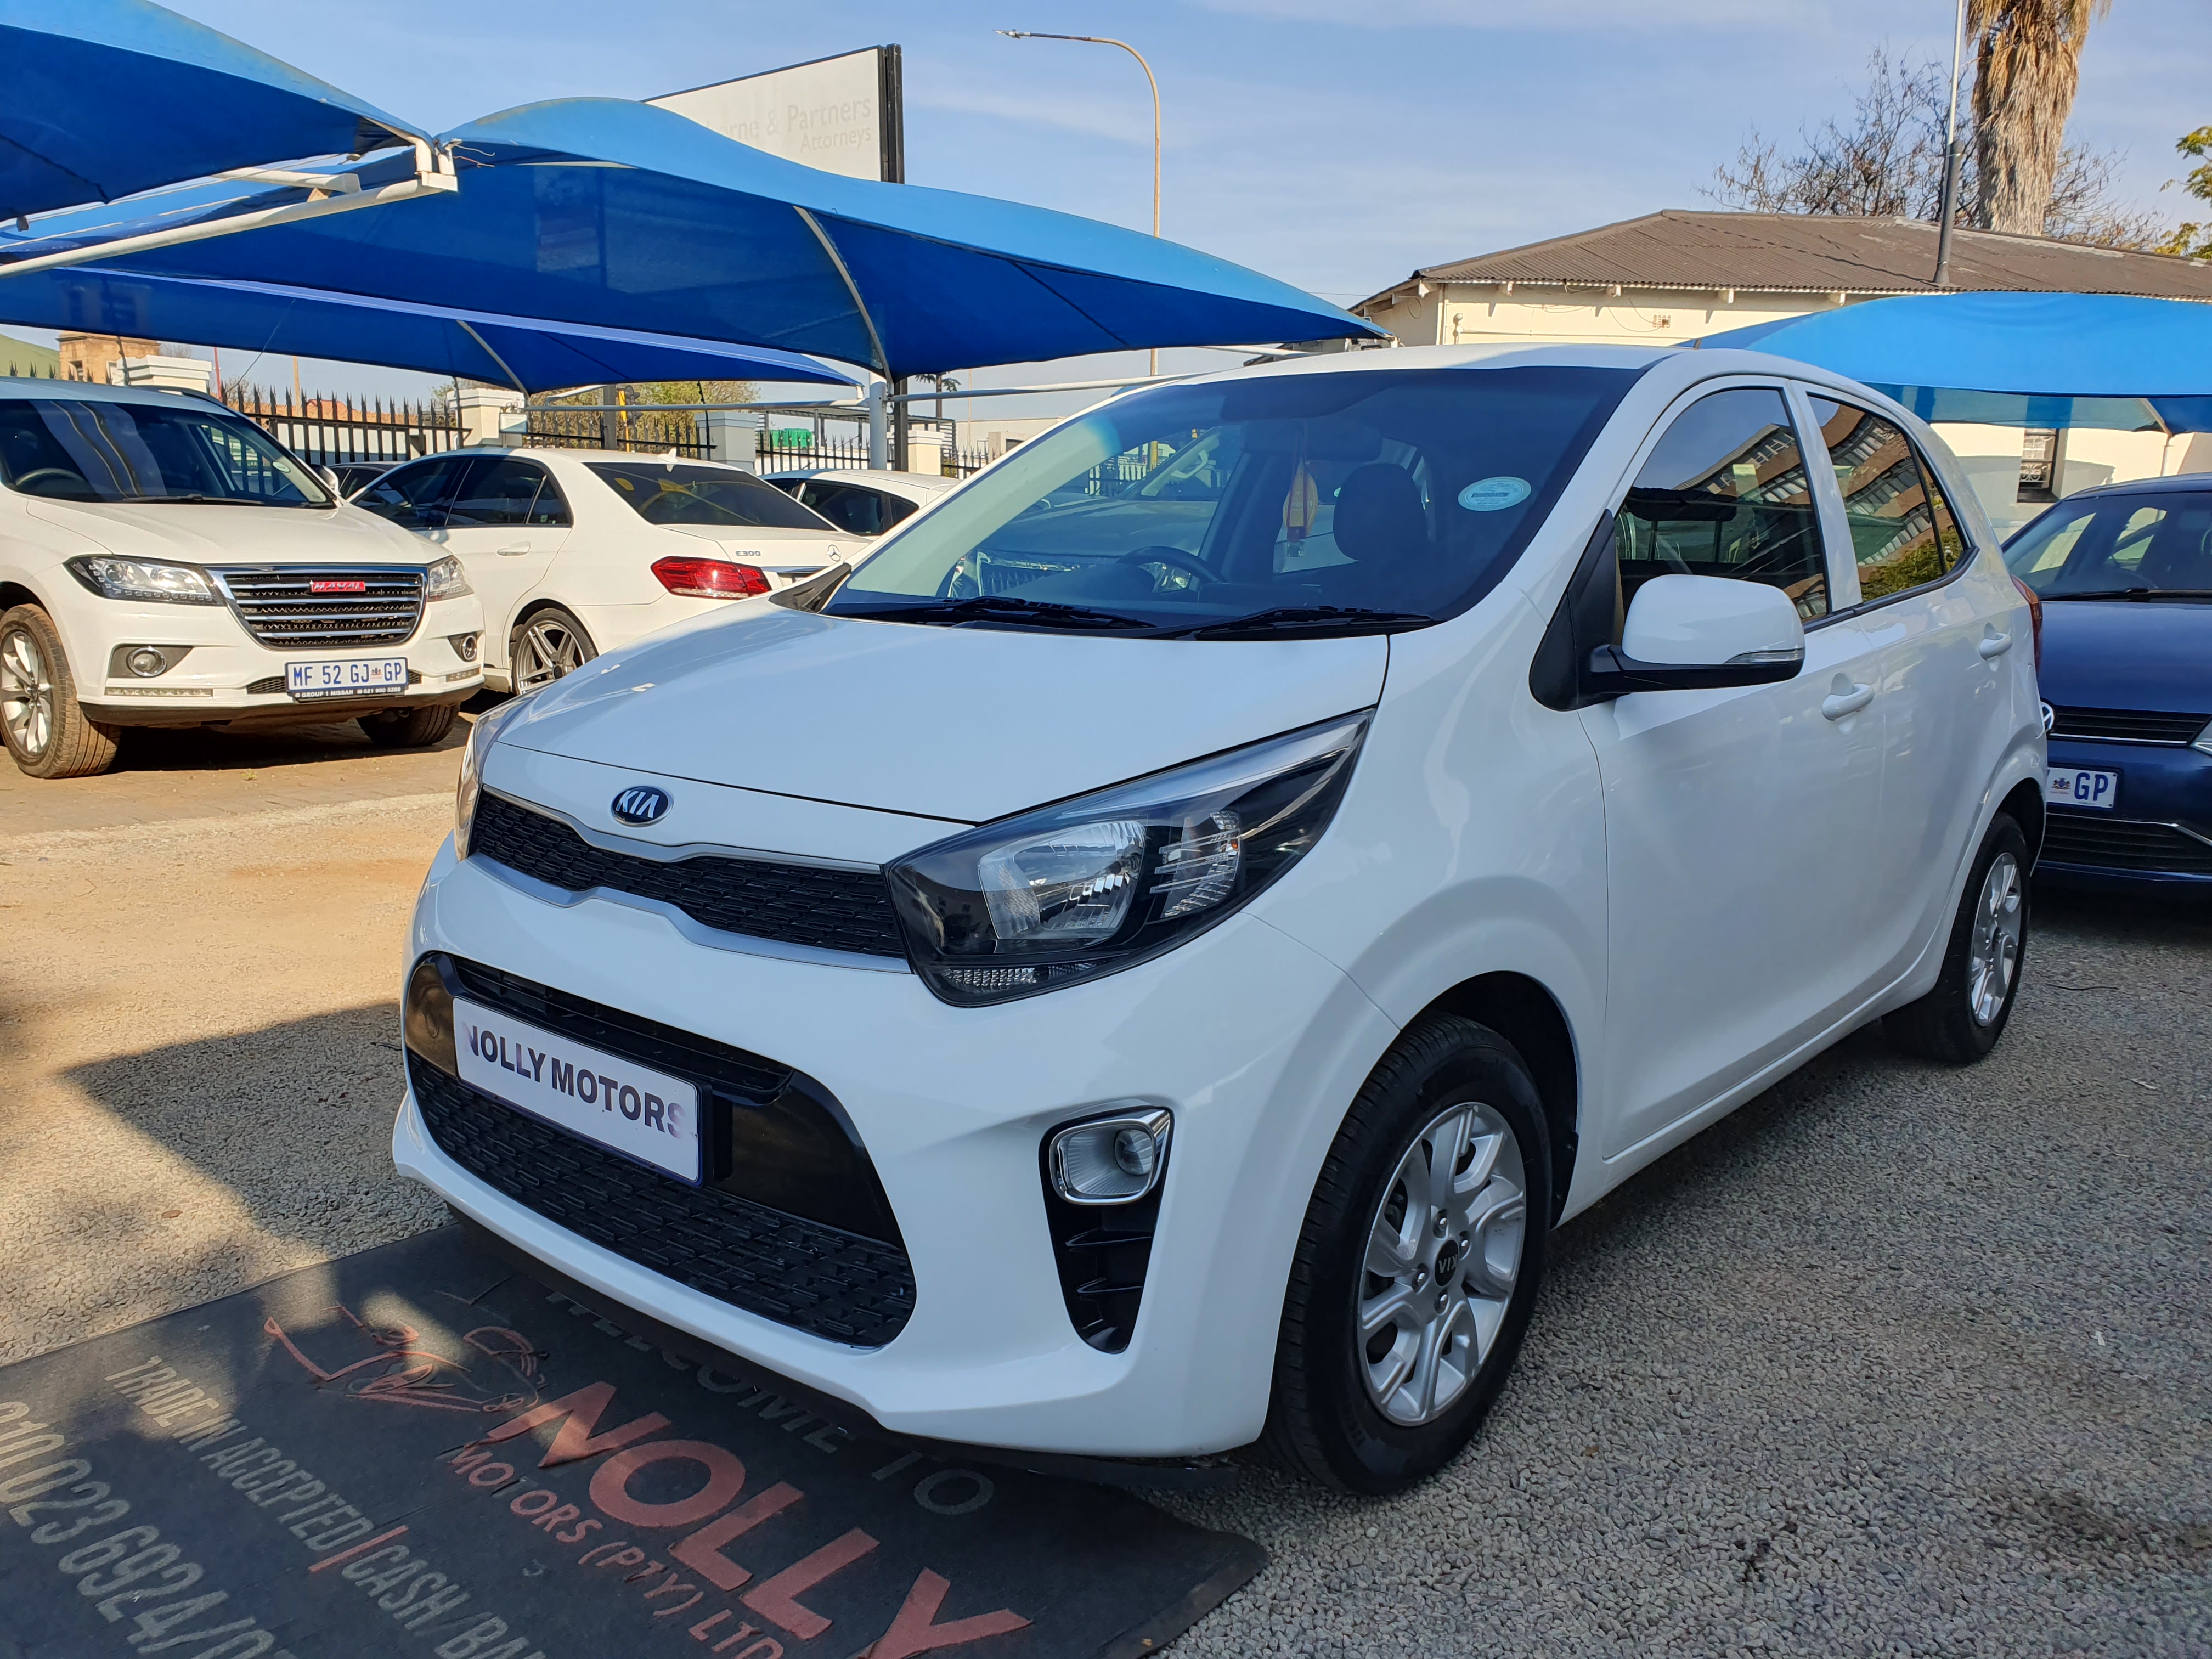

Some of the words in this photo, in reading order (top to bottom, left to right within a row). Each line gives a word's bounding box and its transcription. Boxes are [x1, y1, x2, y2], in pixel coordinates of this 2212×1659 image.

[706, 120, 760, 142] orne
[766, 110, 780, 136] &
[787, 98, 871, 132] Partners
[800, 127, 871, 153] Attorneys
[314, 582, 362, 591] HAVAL
[294, 666, 313, 686] MF
[322, 664, 342, 685] 52
[350, 663, 369, 684] GJ
[384, 662, 402, 682] GP
[615, 789, 660, 819] KIA
[2074, 772, 2109, 802] GP
[462, 1021, 546, 1084] NOLLY
[551, 1057, 686, 1140] MOTORS
[1438, 1254, 1458, 1273] KIA
[104, 1355, 219, 1428] TRADE
[172, 1413, 249, 1453] IN
[199, 1436, 375, 1551] ACCEPTED
[871, 1447, 995, 1515] TO
[436, 1440, 603, 1543] MOTORS
[578, 1541, 704, 1618] (PTY)
[486, 1381, 1034, 1659] NOLLY
